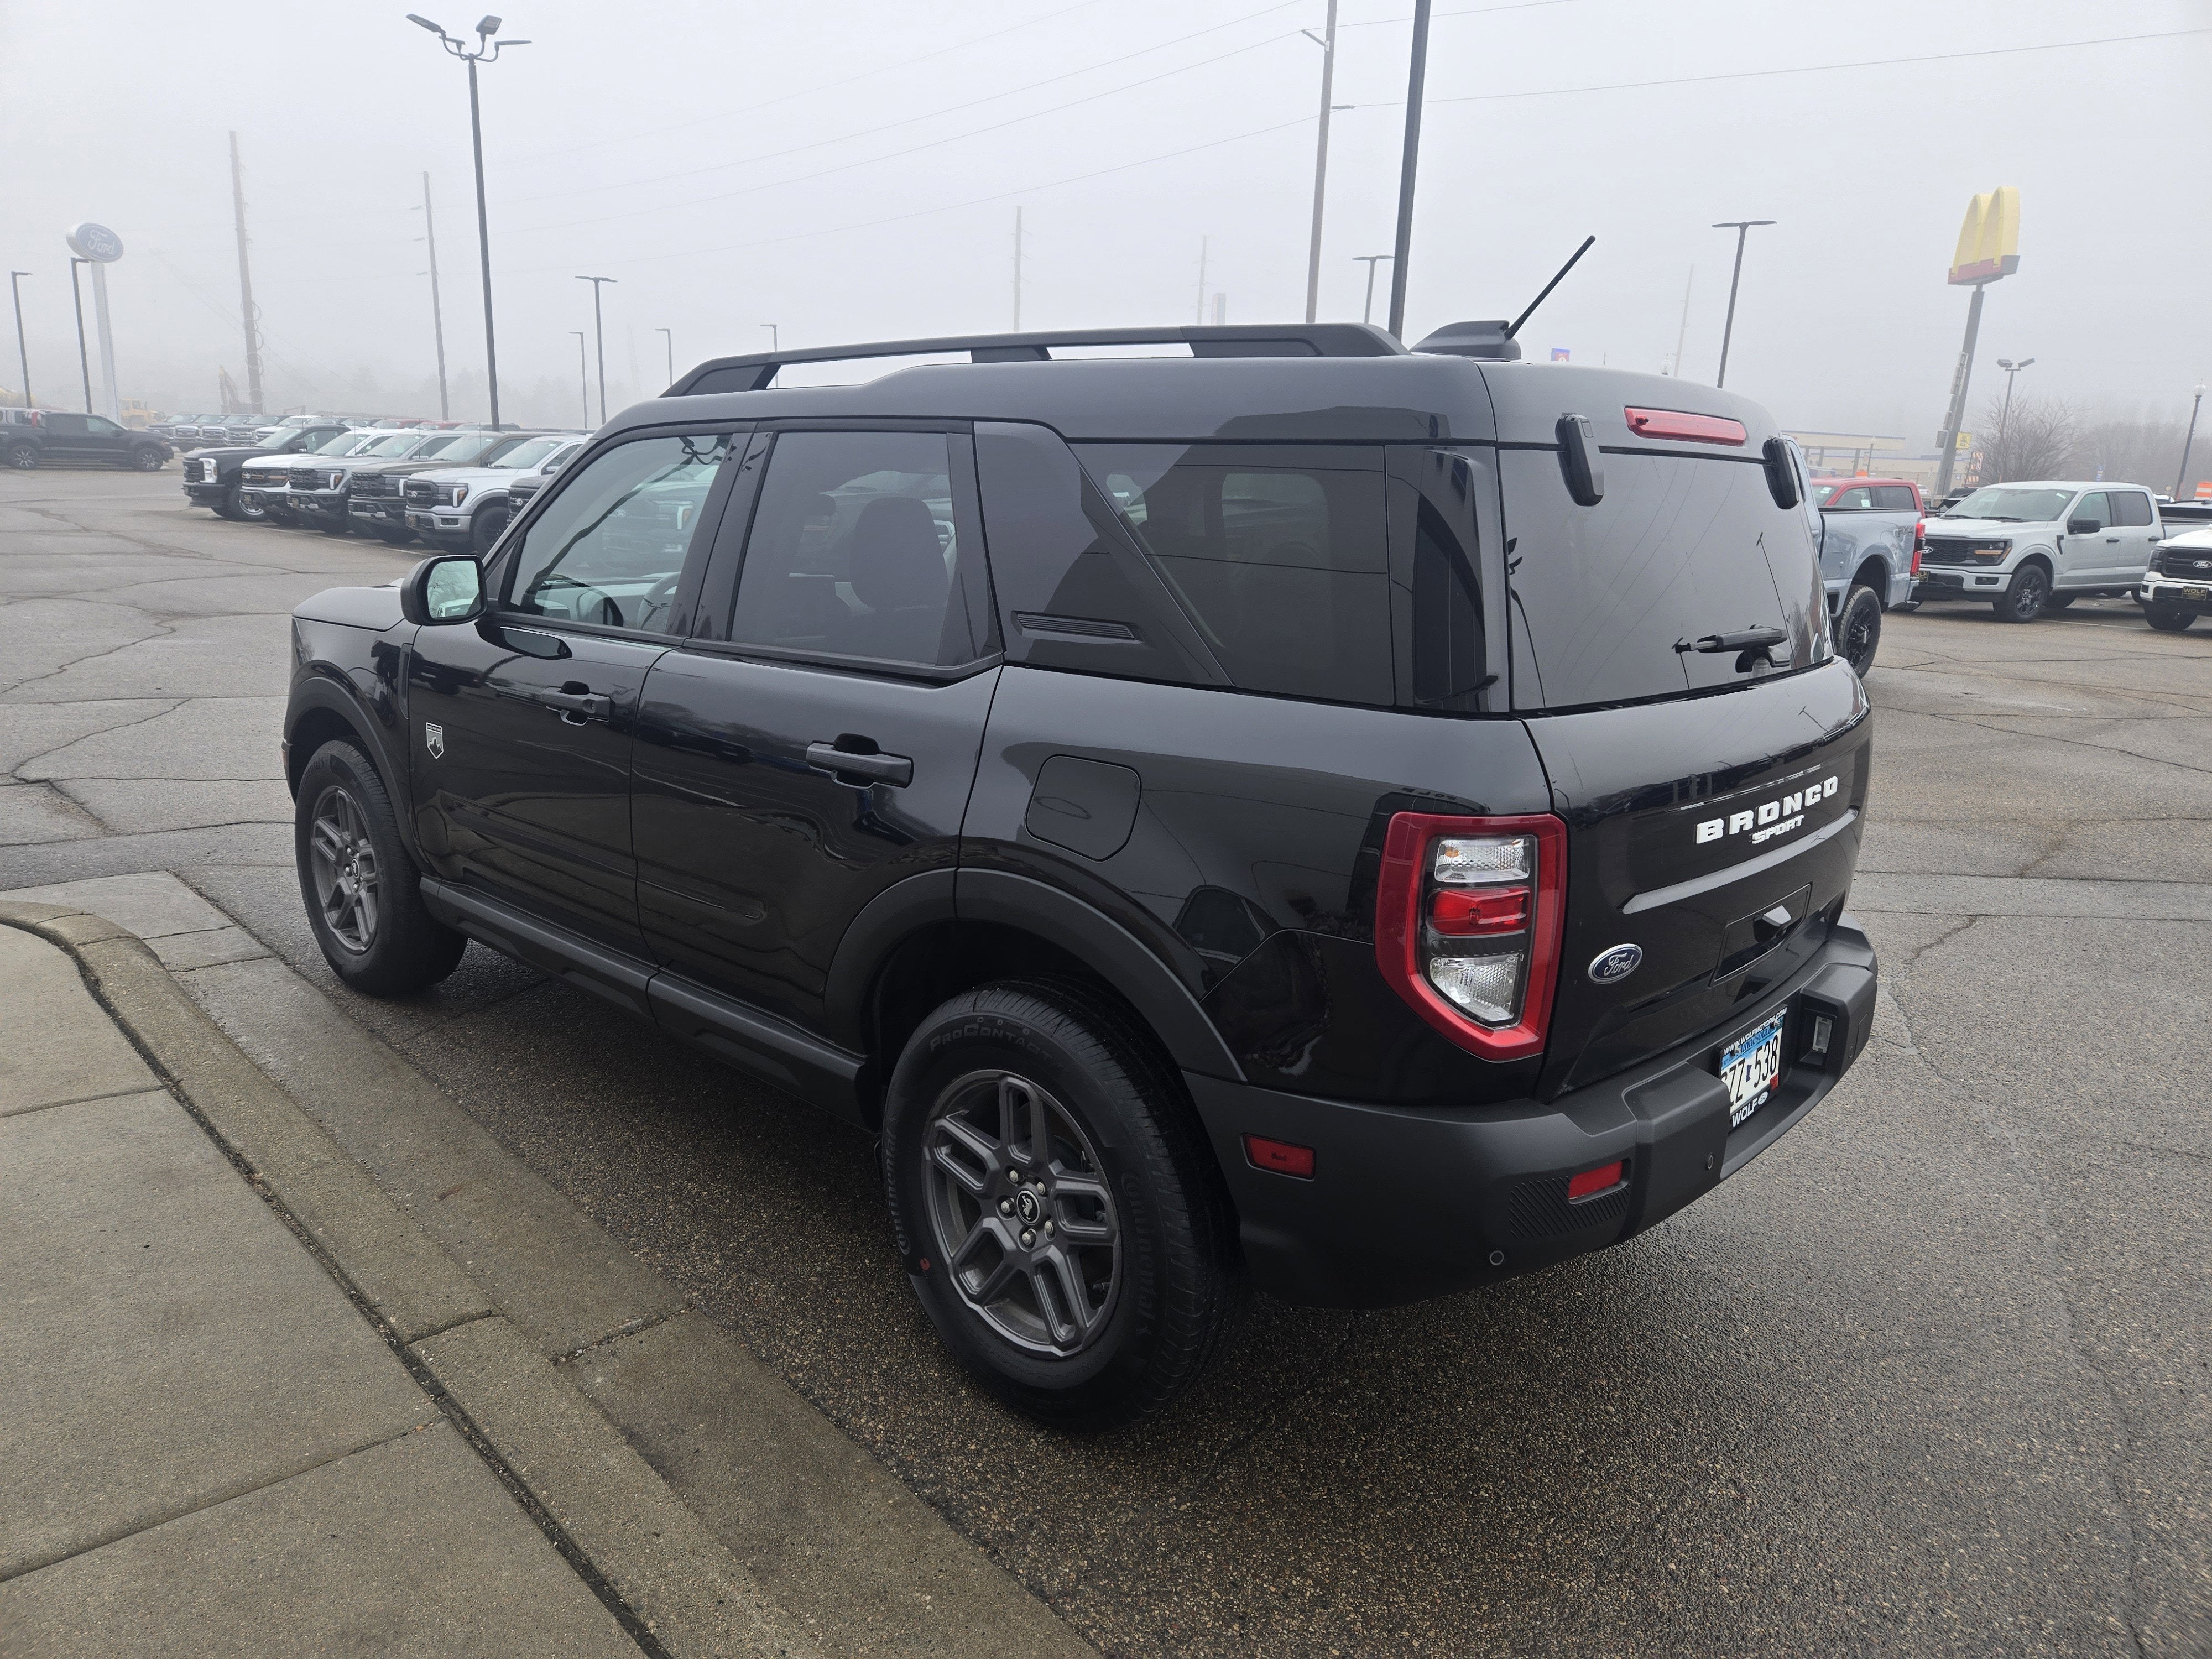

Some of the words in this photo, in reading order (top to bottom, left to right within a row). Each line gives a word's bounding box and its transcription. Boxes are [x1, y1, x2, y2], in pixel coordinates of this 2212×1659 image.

[88, 229, 116, 255] Ford
[1898, 525, 1913, 537] FX4
[1696, 776, 1838, 844] BRONCO
[1751, 815, 1804, 844] SPORT
[1603, 952, 1634, 977] Ford
[1724, 1007, 1787, 1056] WWW.WOLFMOTORS.COM
[1754, 1035, 1778, 1088] 538
[1732, 1097, 1758, 1128] WOLF
[885, 1128, 911, 1256] Continental
[1120, 1171, 1156, 1321] Continental
